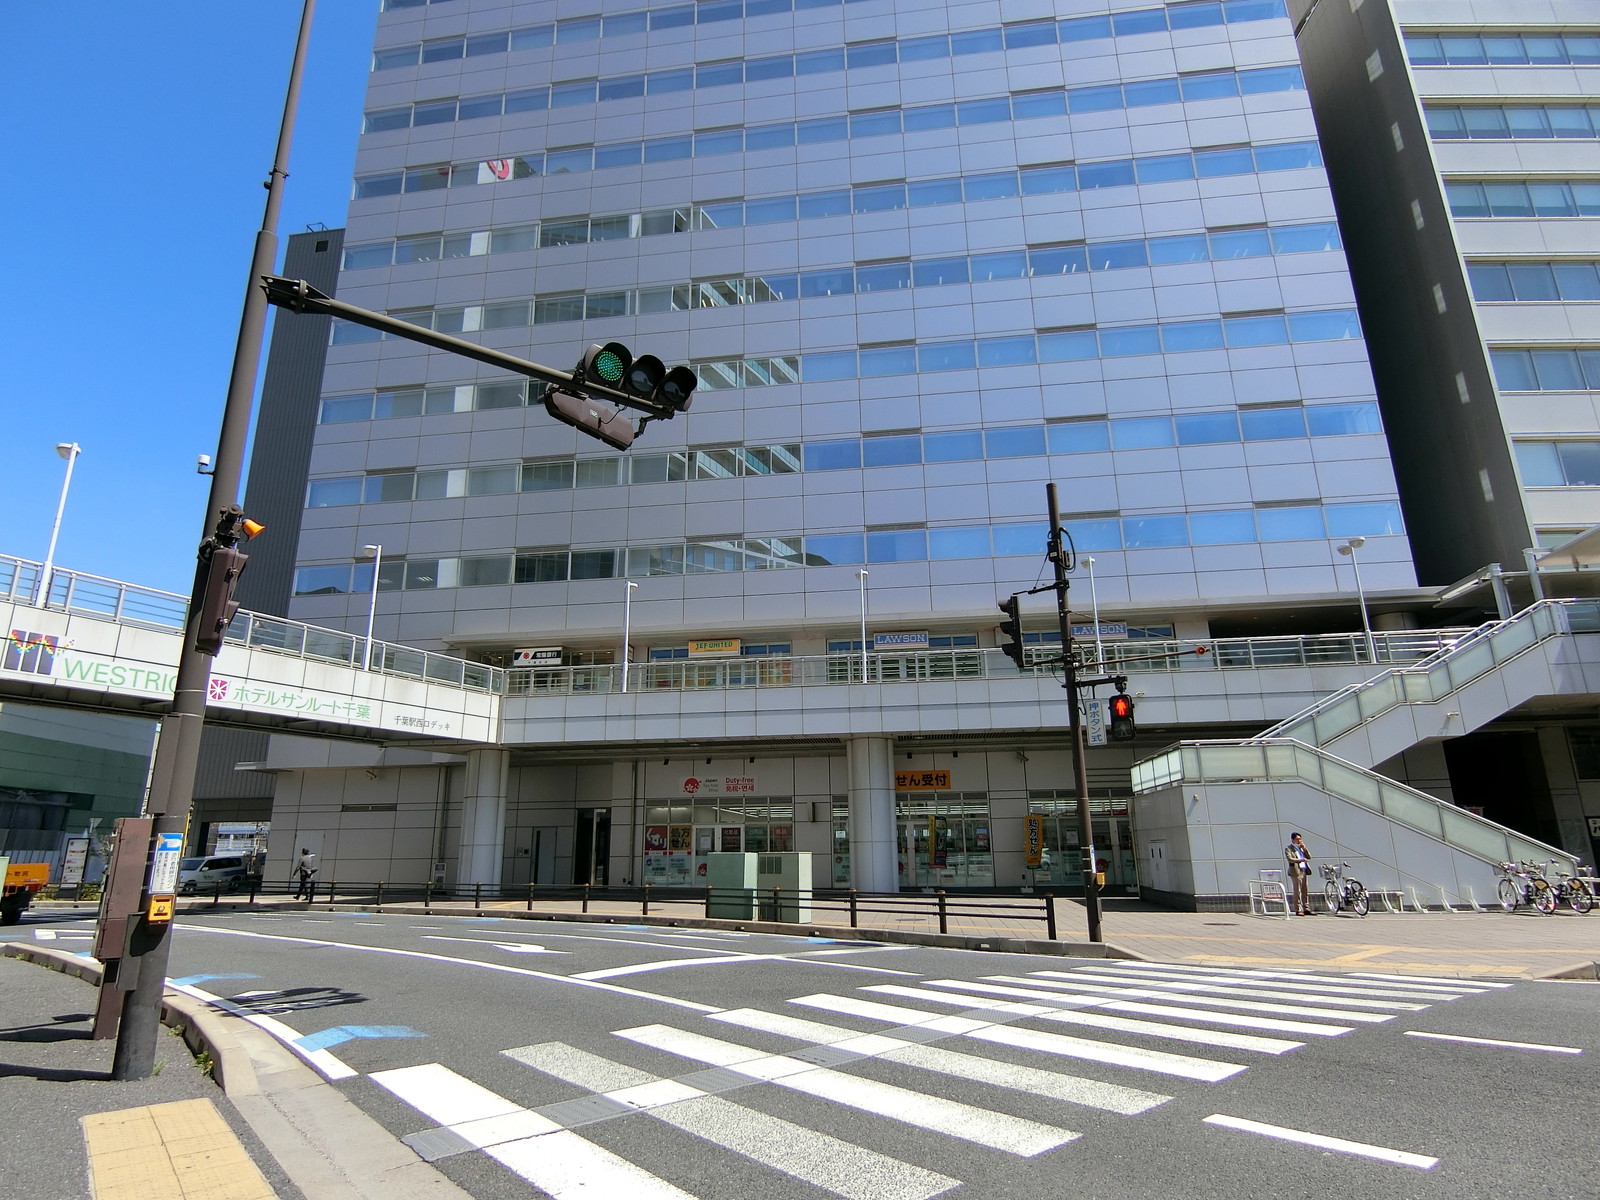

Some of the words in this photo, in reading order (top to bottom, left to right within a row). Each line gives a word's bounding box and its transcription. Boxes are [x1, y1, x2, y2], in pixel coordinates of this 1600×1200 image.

[1073, 625, 1124, 636] LAWSON
[876, 633, 927, 644] LAWSON
[695, 642, 708, 650] JEF
[709, 641, 733, 649] UNITED
[233, 686, 371, 719] ホテルサンルート千葉
[394, 715, 451, 731] 千葉駅西口デッキ
[1088, 702, 1103, 742] 押ボタン式
[896, 773, 947, 786] せん受付
[671, 827, 691, 838] 処方
[1028, 819, 1039, 856] 処方せん
[671, 838, 691, 848] せん
